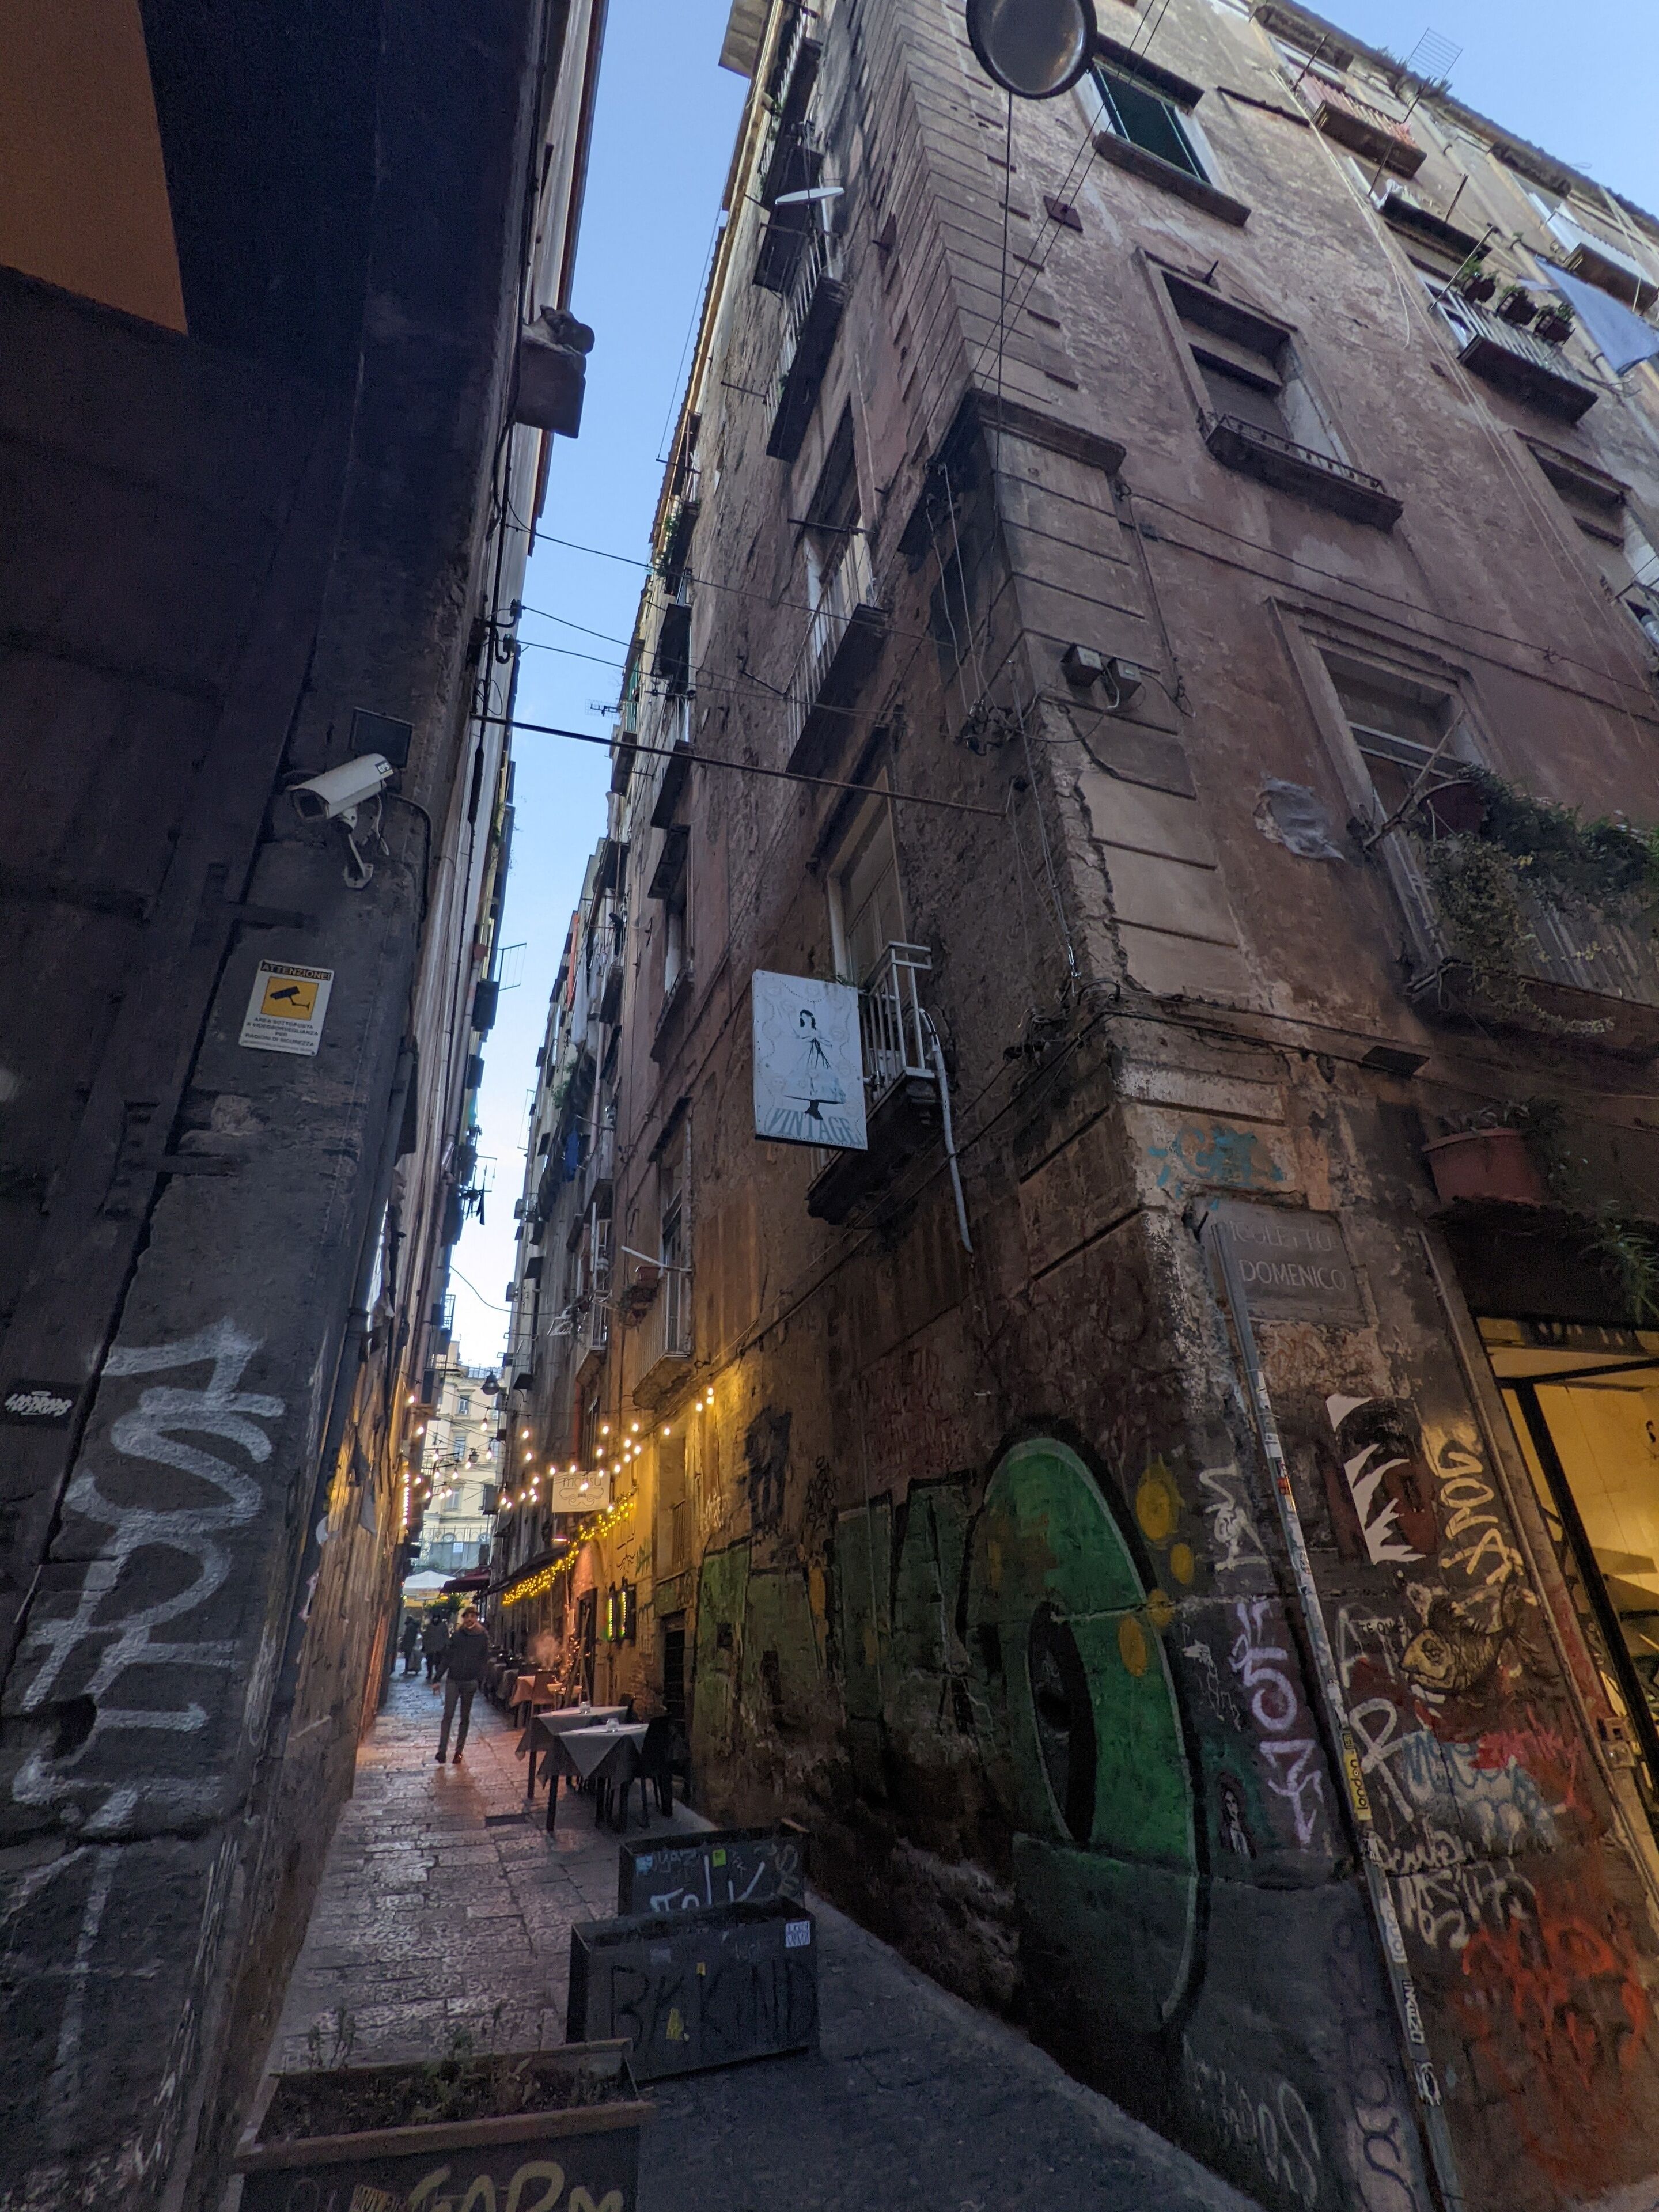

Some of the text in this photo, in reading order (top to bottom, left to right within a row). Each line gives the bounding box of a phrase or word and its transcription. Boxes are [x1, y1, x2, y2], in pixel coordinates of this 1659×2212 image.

[261, 963, 332, 980] ATTENZIONE!
[273, 1020, 313, 1029] SOTTOPOSTA
[766, 1107, 864, 1147] VINTAGE
[1229, 1219, 1333, 1251] ICOLETTO
[1238, 1259, 1347, 1291] DOMENICO
[1350, 1759, 1369, 1809] london
